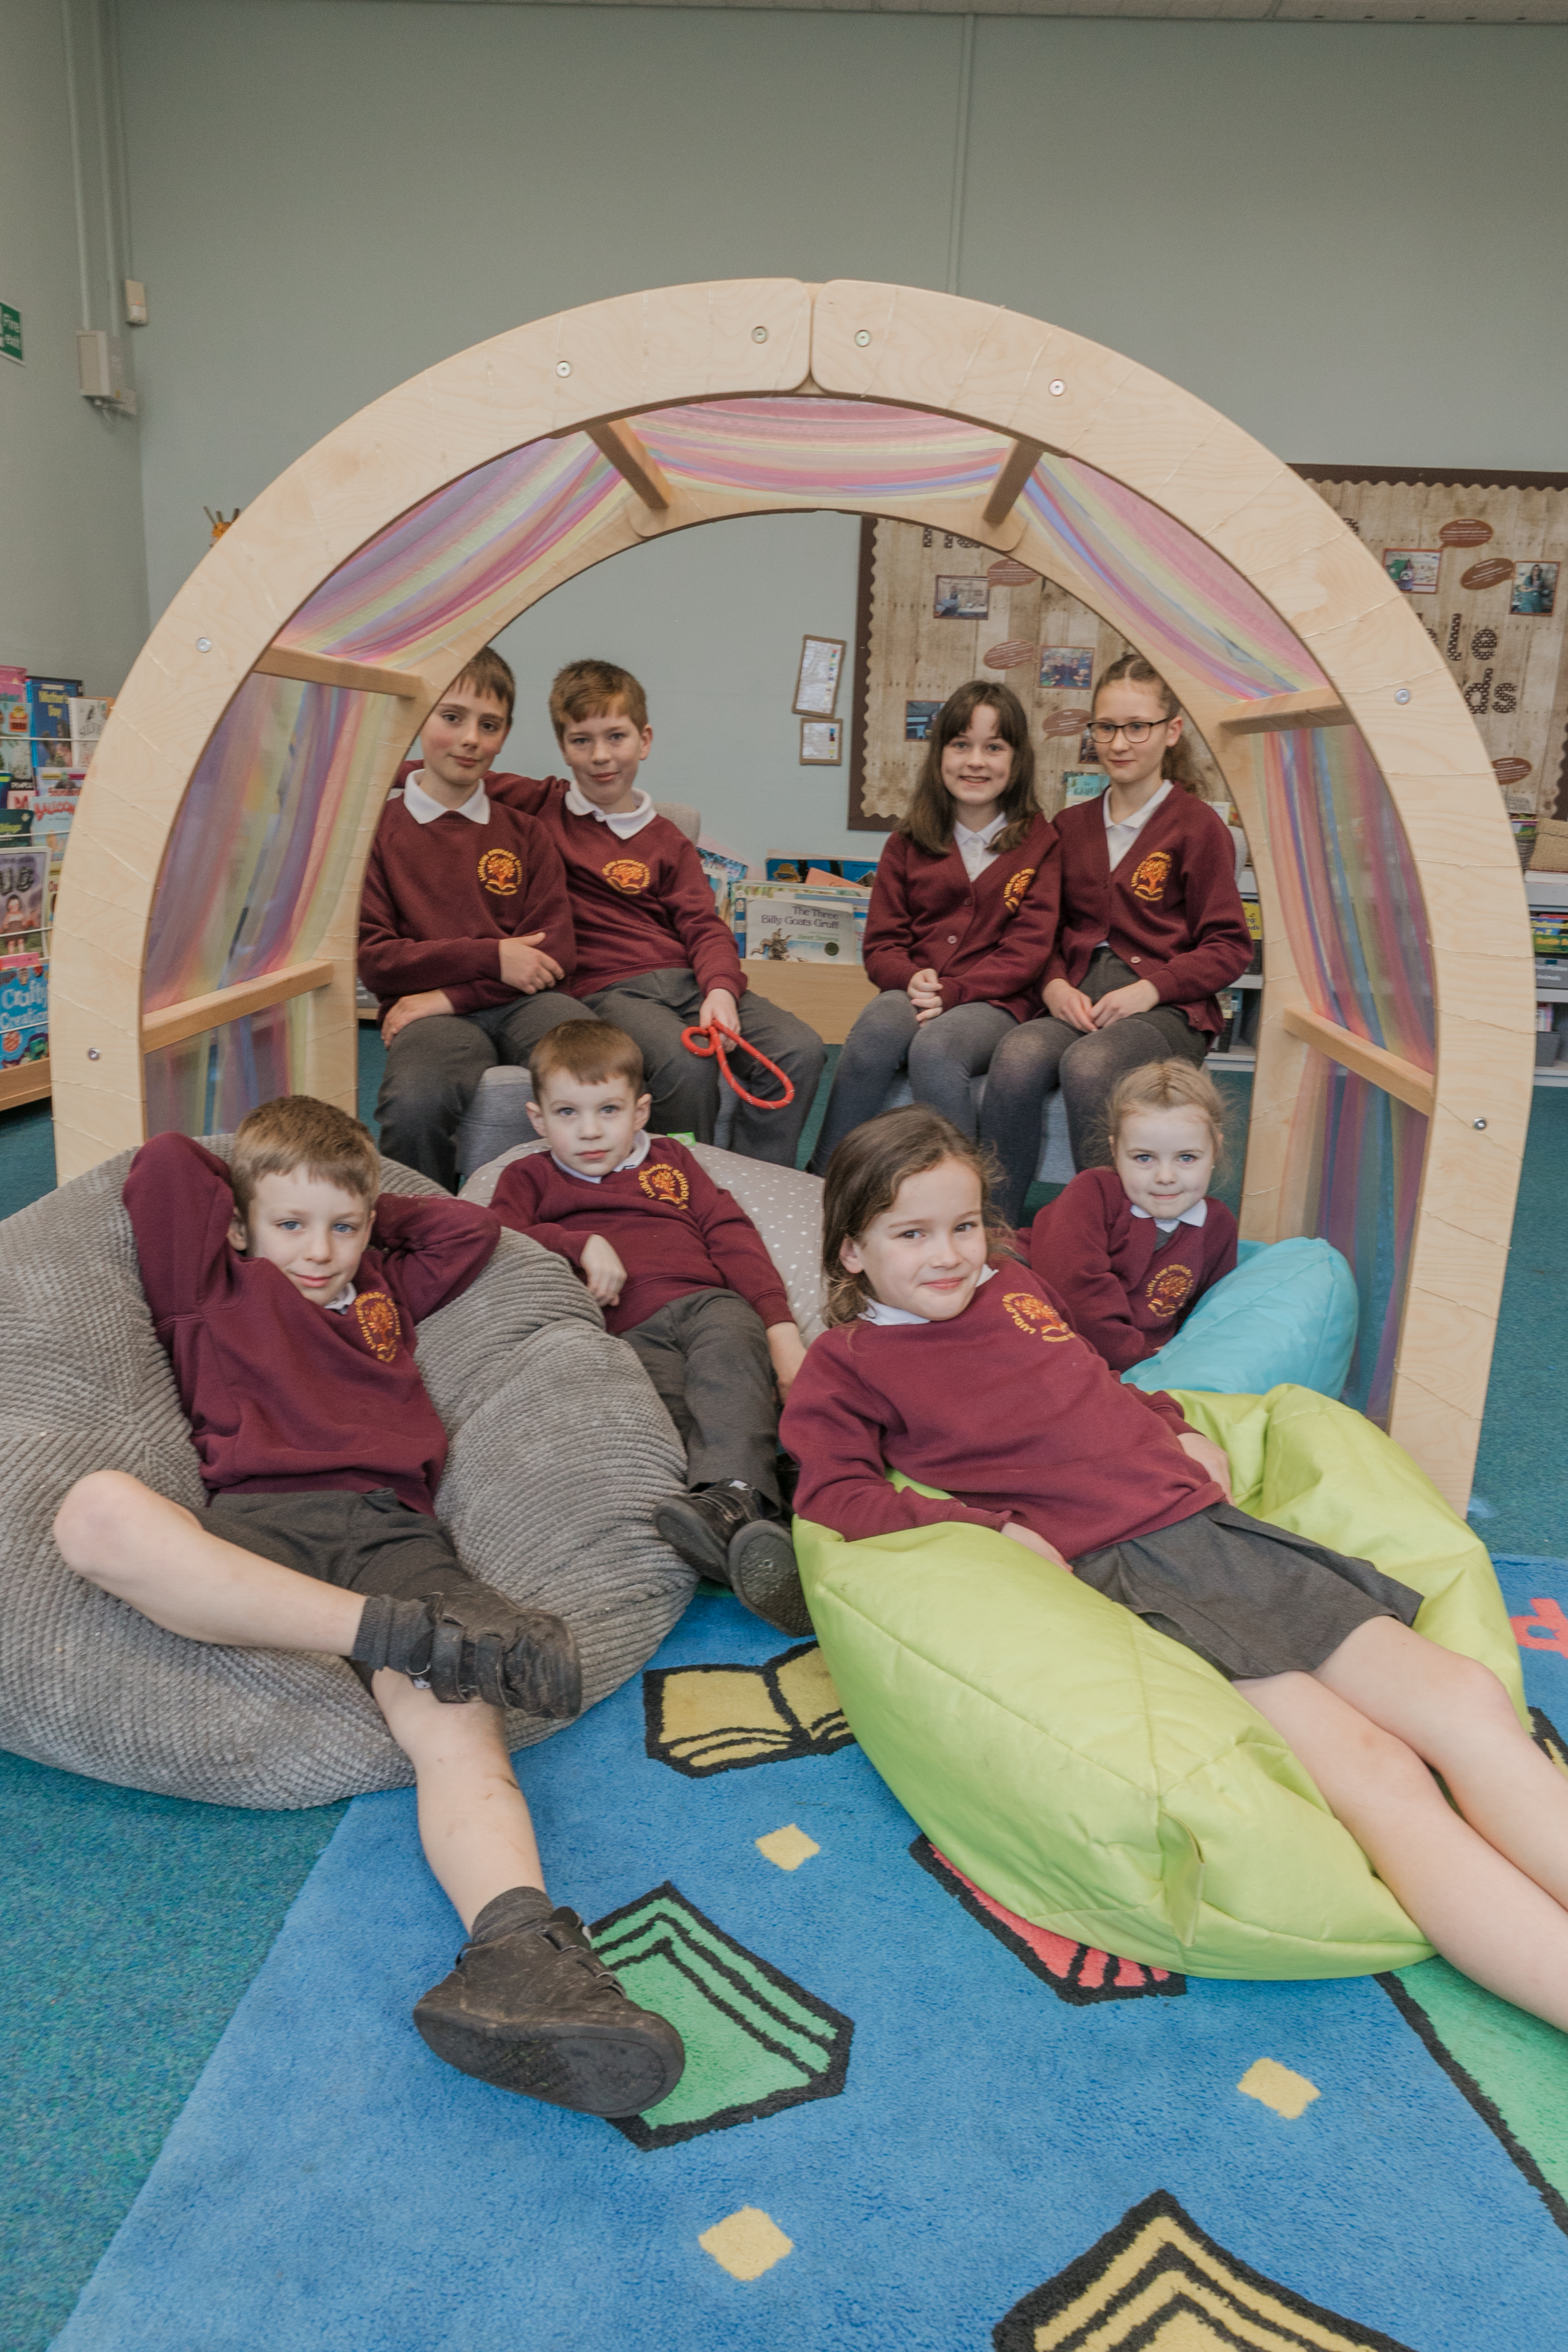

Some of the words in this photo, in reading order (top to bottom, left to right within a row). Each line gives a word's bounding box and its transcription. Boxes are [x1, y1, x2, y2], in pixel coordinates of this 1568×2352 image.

[792, 906, 810, 916] The
[811, 908, 839, 920] Three
[761, 914, 782, 926] Billy
[784, 916, 812, 927] Goats
[813, 919, 840, 929] Gruff
[672, 1169, 689, 1201] SCHOOL
